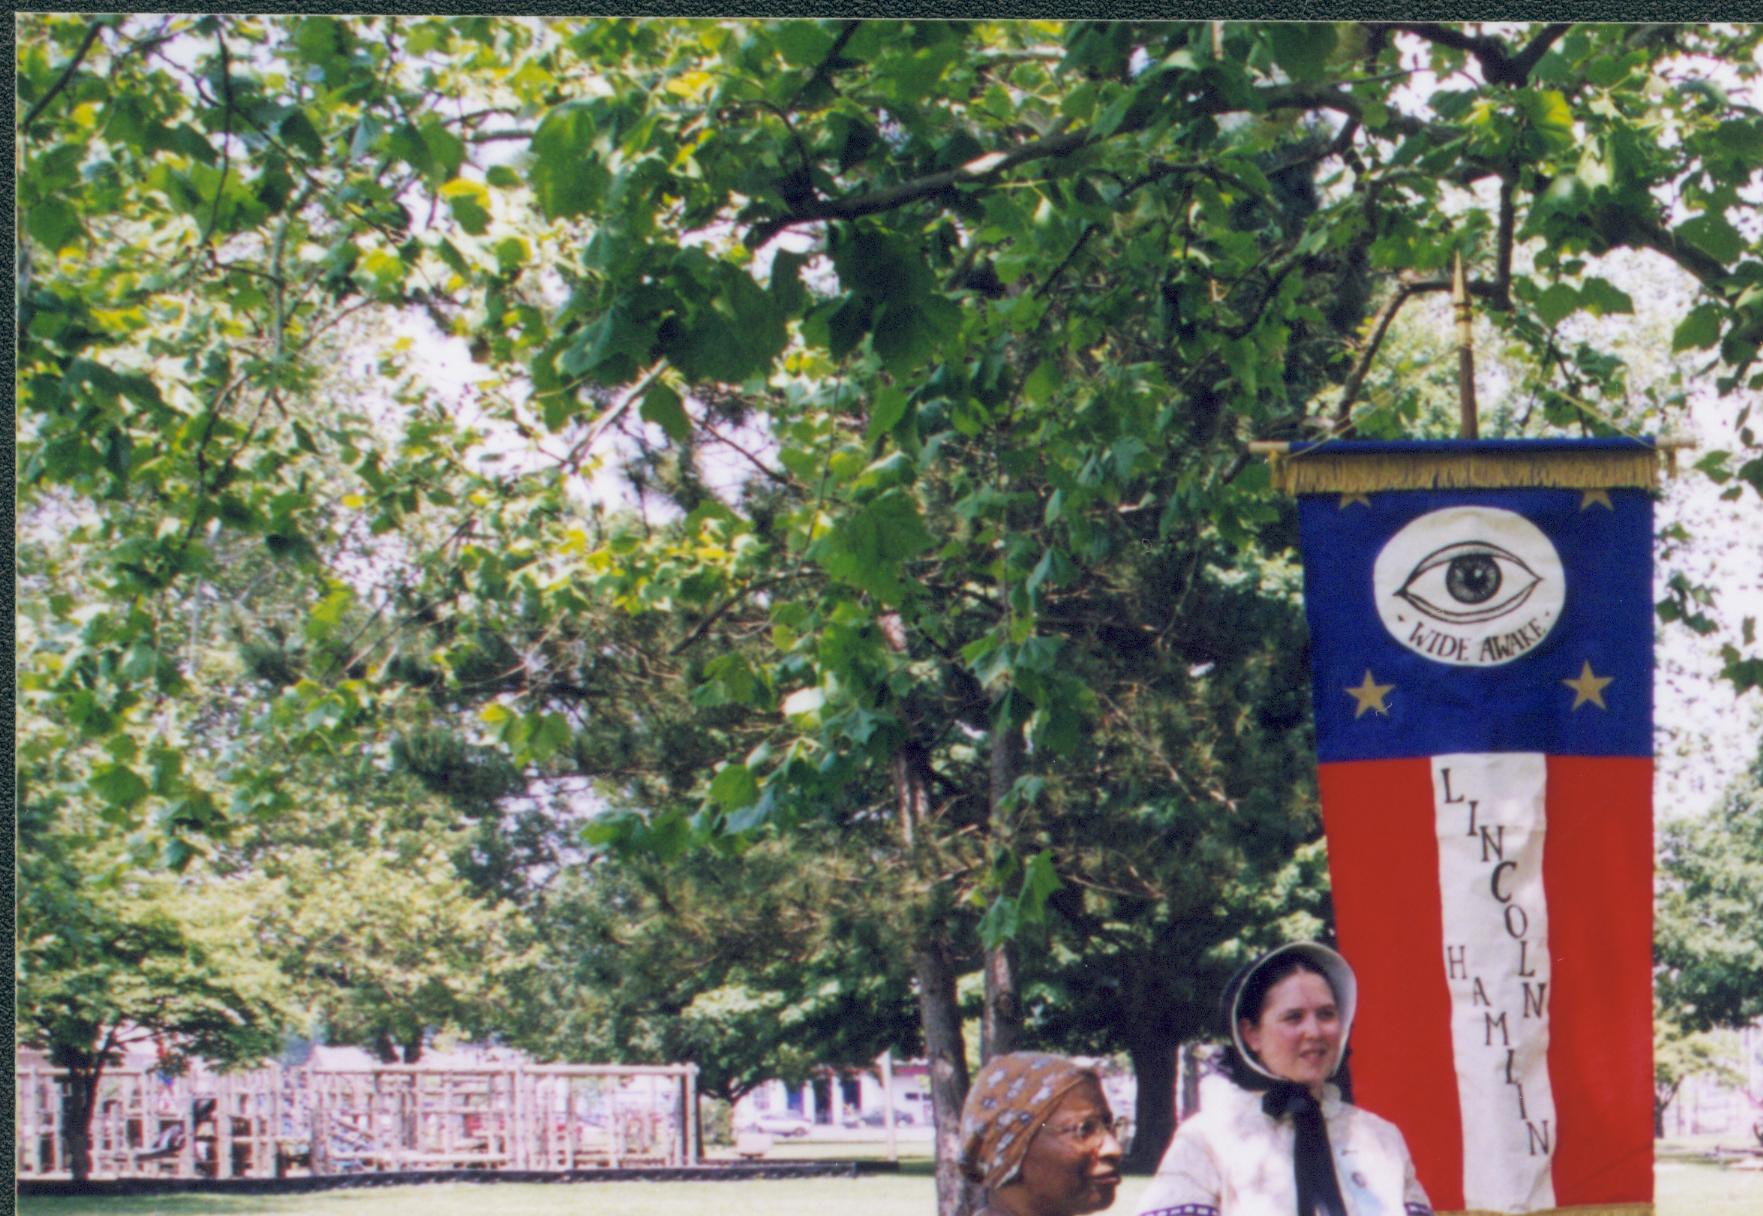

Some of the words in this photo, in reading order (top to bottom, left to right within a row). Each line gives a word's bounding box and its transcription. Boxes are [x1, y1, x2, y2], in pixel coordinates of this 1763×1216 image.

[1409, 621, 1471, 661] WIDE
[1478, 617, 1542, 662] AWAKE
[1440, 768, 1546, 1018] LINCOLN
[1447, 945, 1550, 1156] HAMLIN
